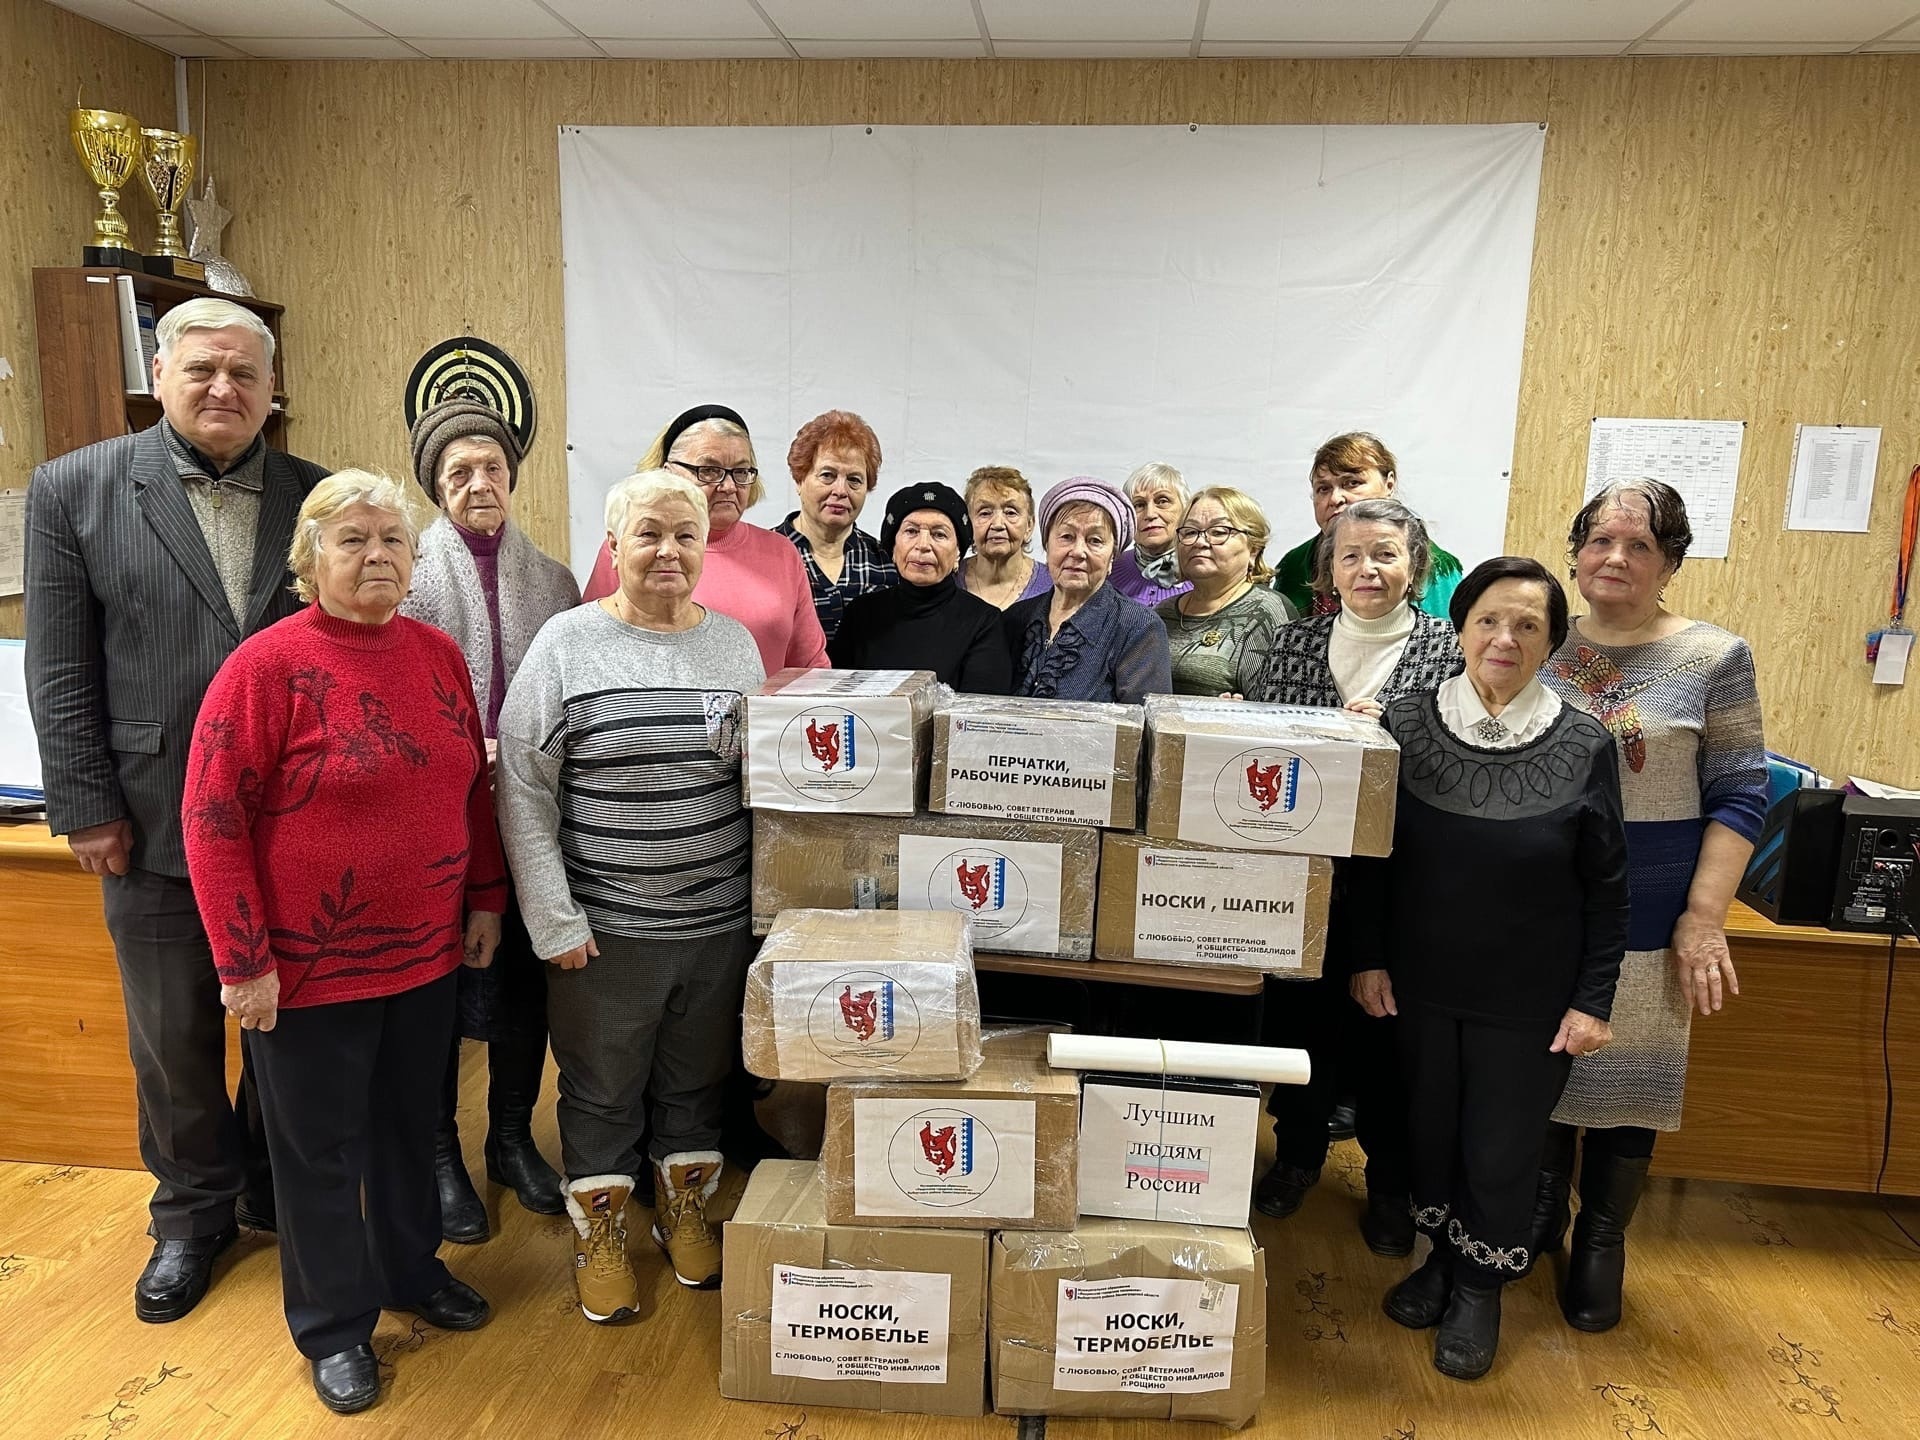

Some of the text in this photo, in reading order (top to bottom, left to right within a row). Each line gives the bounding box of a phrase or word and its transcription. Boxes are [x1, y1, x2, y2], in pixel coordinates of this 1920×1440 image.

[988, 755, 1070, 774] ПЕРЧАТКИ,
[951, 768, 1106, 791] РАБОЧИЕ РУКАВИЦЫ
[956, 801, 1005, 812] ЛЮБОВЬЮ,
[1006, 805, 1031, 813] СОВЕТ
[1032, 807, 1075, 816] ВЕТЕРАНОВ
[1013, 813, 1055, 822] ОБЩЕСТВО
[1056, 817, 1104, 826] ИНВАЛИДОВ
[1141, 893, 1206, 910] НОСКИ
[1222, 897, 1295, 914] ШАПКИ
[1222, 937, 1267, 946] ВЕТЕРАНОВ
[1196, 952, 1239, 960] П.РОЩИНО
[1123, 1102, 1216, 1128] Лучшим
[1129, 1142, 1203, 1161] людям
[1125, 1171, 1201, 1195] России
[819, 1303, 900, 1324] НОСКИ,
[1106, 1312, 1185, 1331] НОСКИ,
[787, 1323, 929, 1344] ТЕРМОБЕЛЬЕ
[1074, 1333, 1214, 1353] ТЕРМОБЕЛЬЕ
[783, 1352, 836, 1364] ЛЮБОВЬЮ,
[836, 1355, 863, 1363] СОВЕТ
[864, 1356, 910, 1365] ВЕТЕРАНОВ
[844, 1362, 889, 1371] ОБЩЕСТВО
[890, 1364, 941, 1372] ИНВАЛИДОВ
[836, 1369, 881, 1377] П.РОЩИНО
[1066, 1366, 1120, 1377] ЛЮБОВЬЮ,
[1122, 1365, 1148, 1374] СОВЕТ
[1149, 1366, 1195, 1374] ВЕТЕРАНОВ
[1129, 1373, 1174, 1382] ОБЩЕСТВО
[1175, 1371, 1225, 1382] ИНВАЛИДОВ
[1120, 1380, 1166, 1390] П.РОЩИНО
